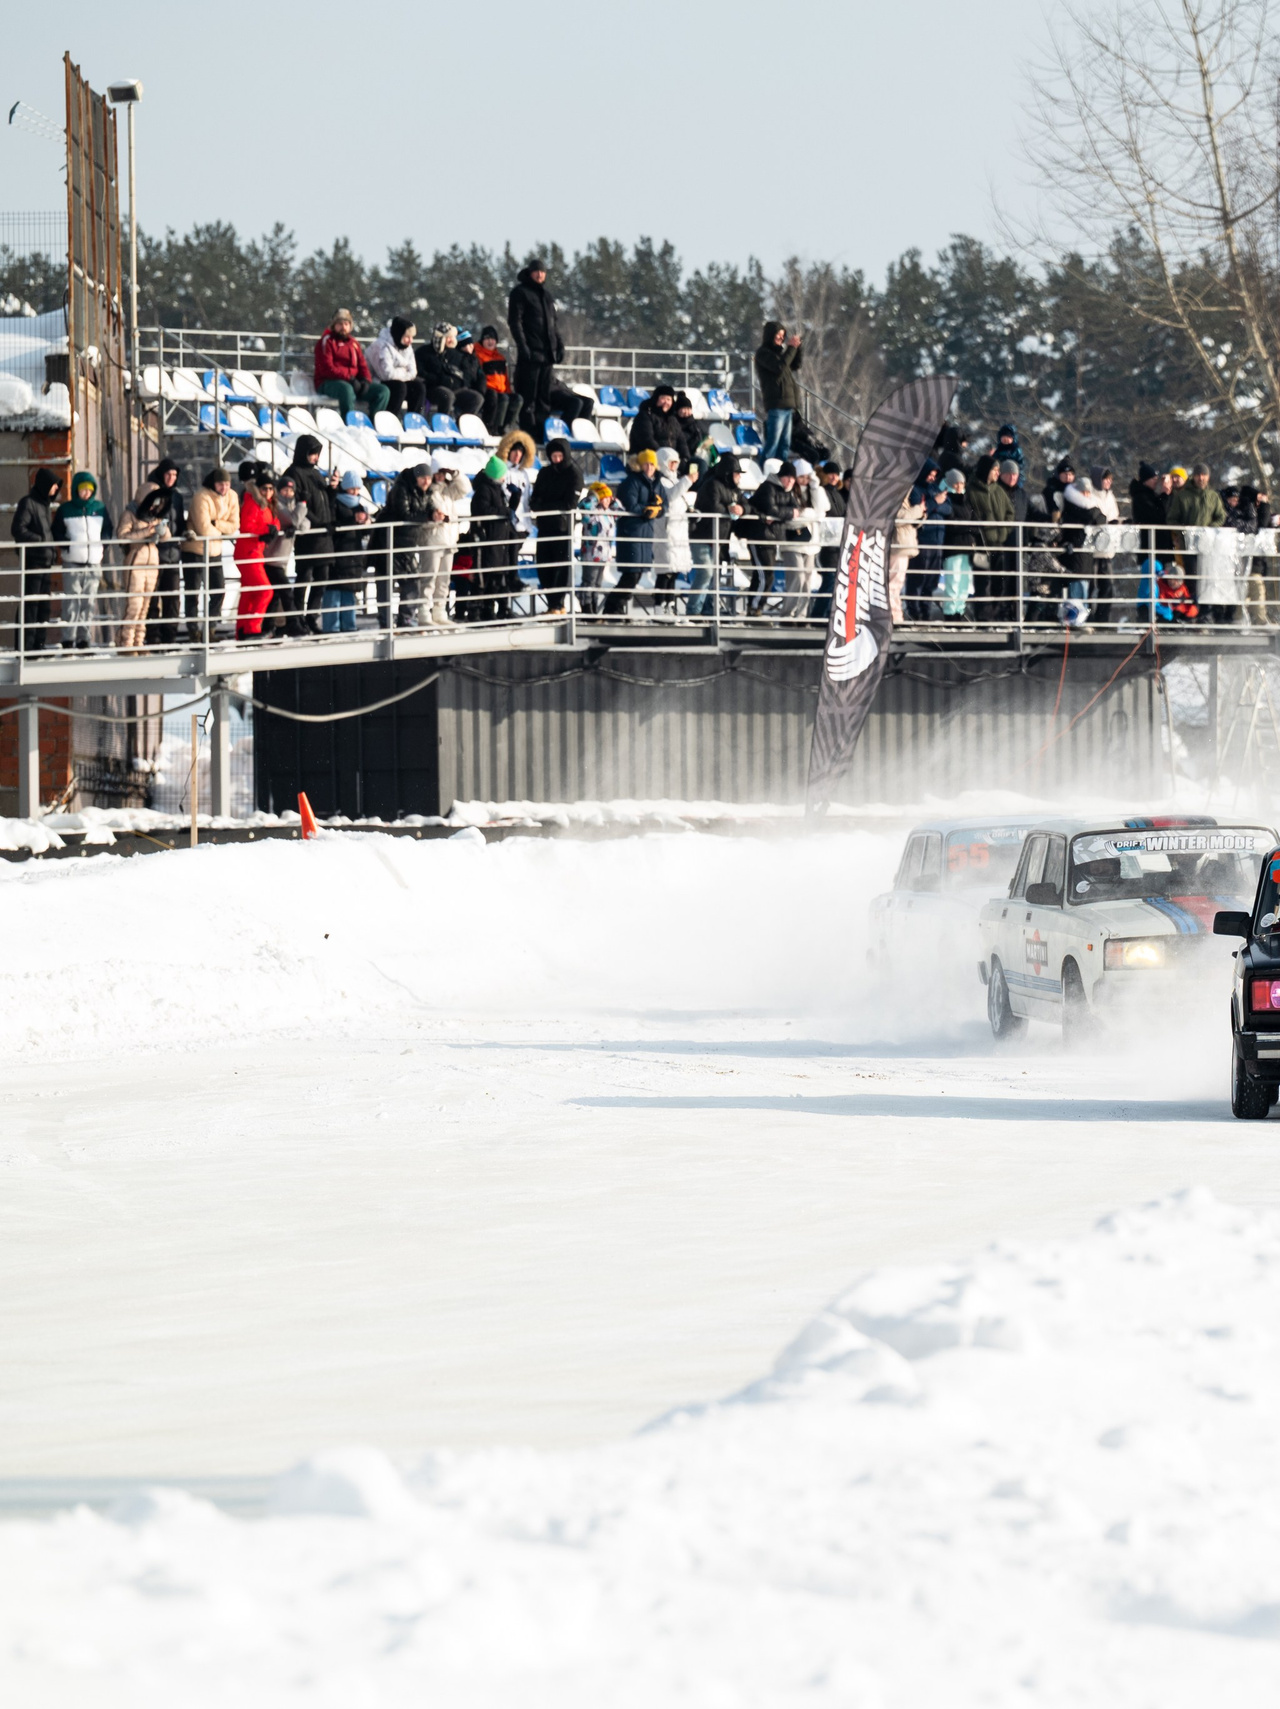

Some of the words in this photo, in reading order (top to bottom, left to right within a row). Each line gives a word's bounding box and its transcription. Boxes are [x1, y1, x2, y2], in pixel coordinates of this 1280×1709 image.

[1116, 840, 1145, 848] DRIFT
[1147, 836, 1207, 851] WINTER
[1209, 835, 1255, 850] MODE
